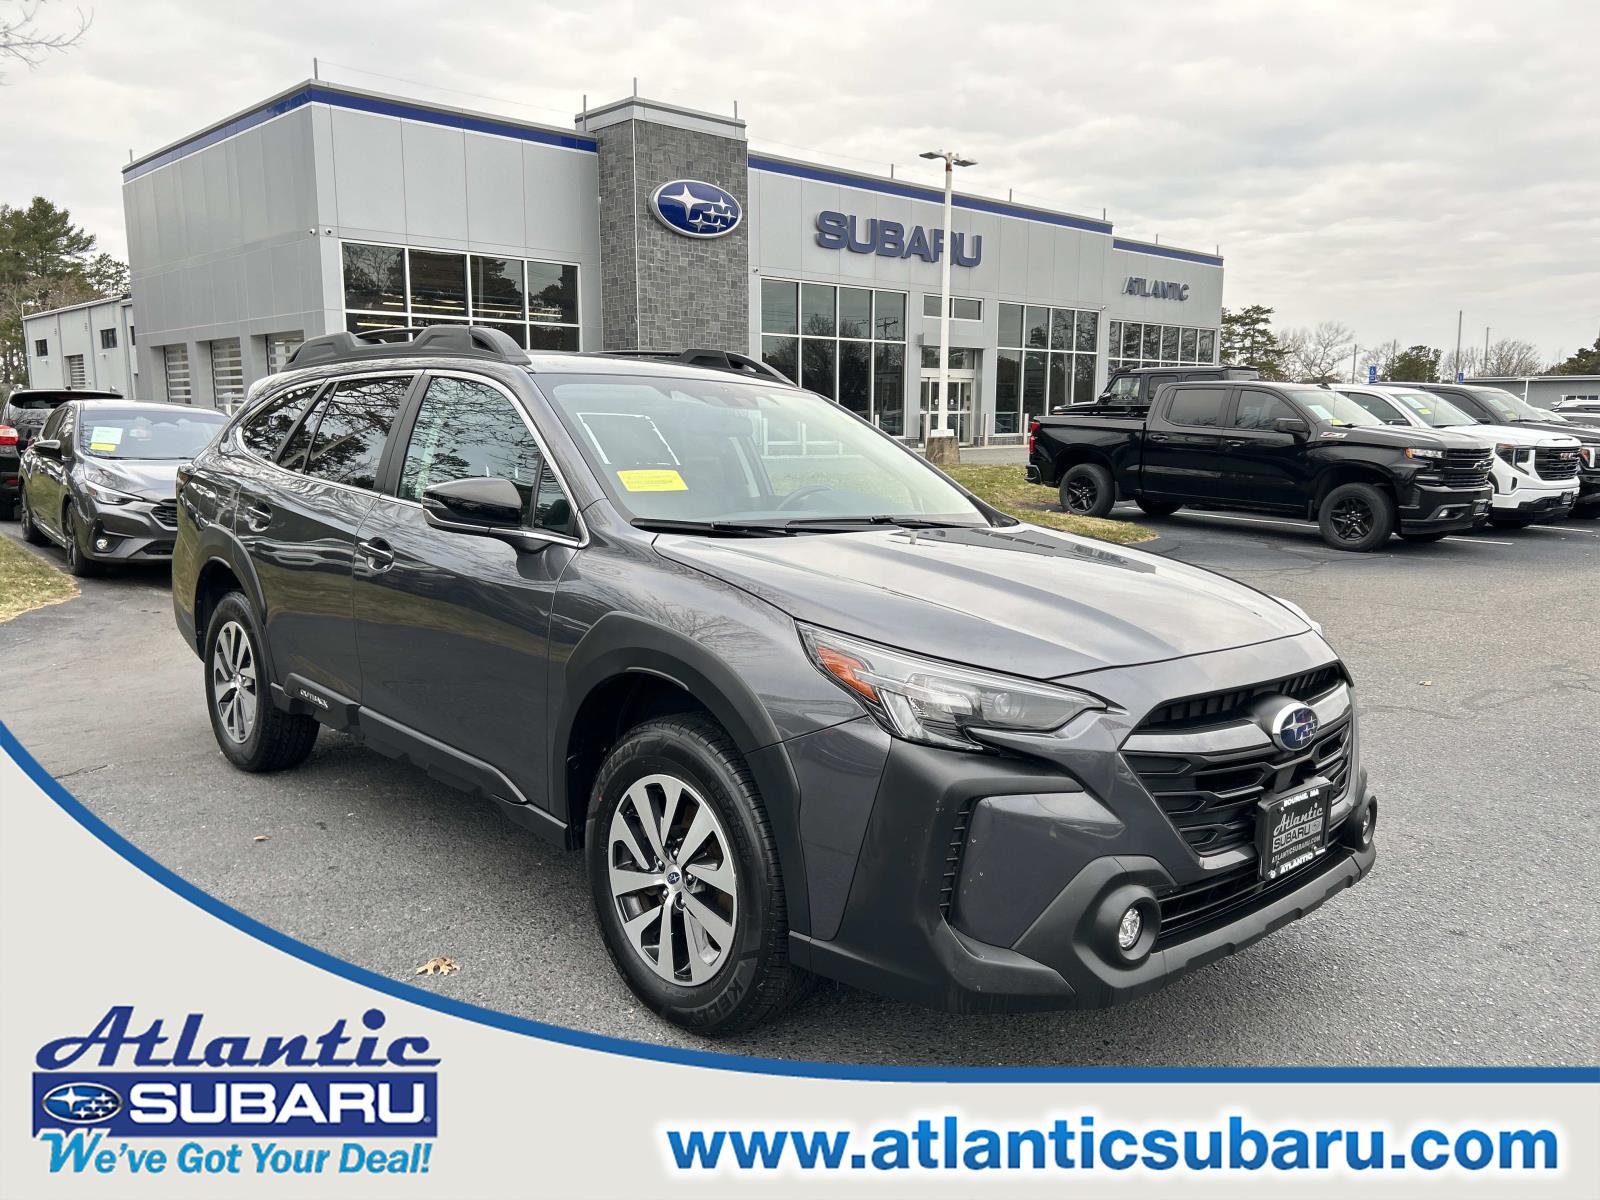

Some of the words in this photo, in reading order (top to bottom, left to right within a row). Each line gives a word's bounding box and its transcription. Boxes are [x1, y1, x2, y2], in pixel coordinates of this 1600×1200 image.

[816, 210, 982, 267] SUBARU
[1122, 276, 1189, 301] ATLANTIC
[1273, 802, 1323, 836] Atlantic
[1273, 825, 1311, 850] SUBARU
[1280, 853, 1313, 874] ATLANTIC
